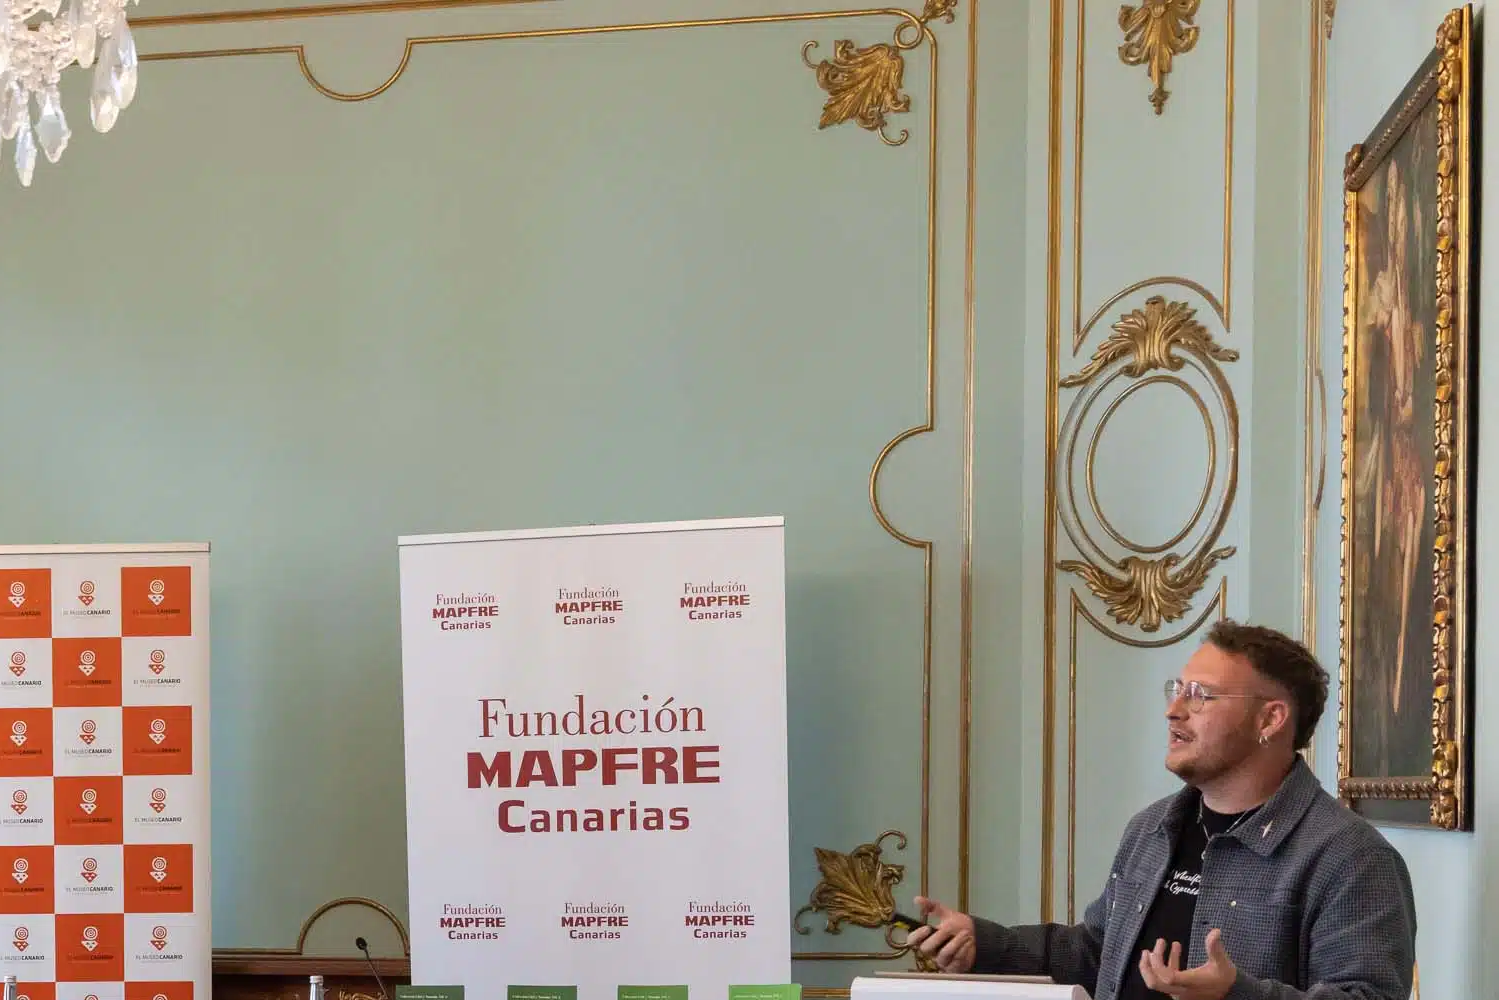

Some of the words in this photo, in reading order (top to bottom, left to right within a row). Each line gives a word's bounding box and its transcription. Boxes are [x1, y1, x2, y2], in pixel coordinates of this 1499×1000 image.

[558, 587, 620, 599] Fundación
[683, 581, 747, 594] Fundación
[436, 592, 495, 605] Fundación
[679, 594, 751, 608] MAPFRE
[432, 605, 499, 619] MAPFRE
[555, 600, 623, 613] MAPFRE
[563, 613, 615, 626] Canarias
[688, 608, 742, 620] Canarias
[440, 619, 492, 631] Canarias
[478, 694, 707, 739] Fundación
[466, 745, 721, 789] MAPFRE
[497, 799, 690, 833] Canarias
[443, 903, 503, 916] Fundación
[563, 902, 625, 915] Fundación
[688, 900, 751, 914] Fundación
[440, 916, 506, 928] MAPFRE
[561, 915, 629, 928] MAPFRE
[685, 914, 755, 927] MAPFRE
[447, 929, 499, 941] Canarias
[569, 928, 621, 940] Canarias
[693, 927, 747, 939] Canarias
